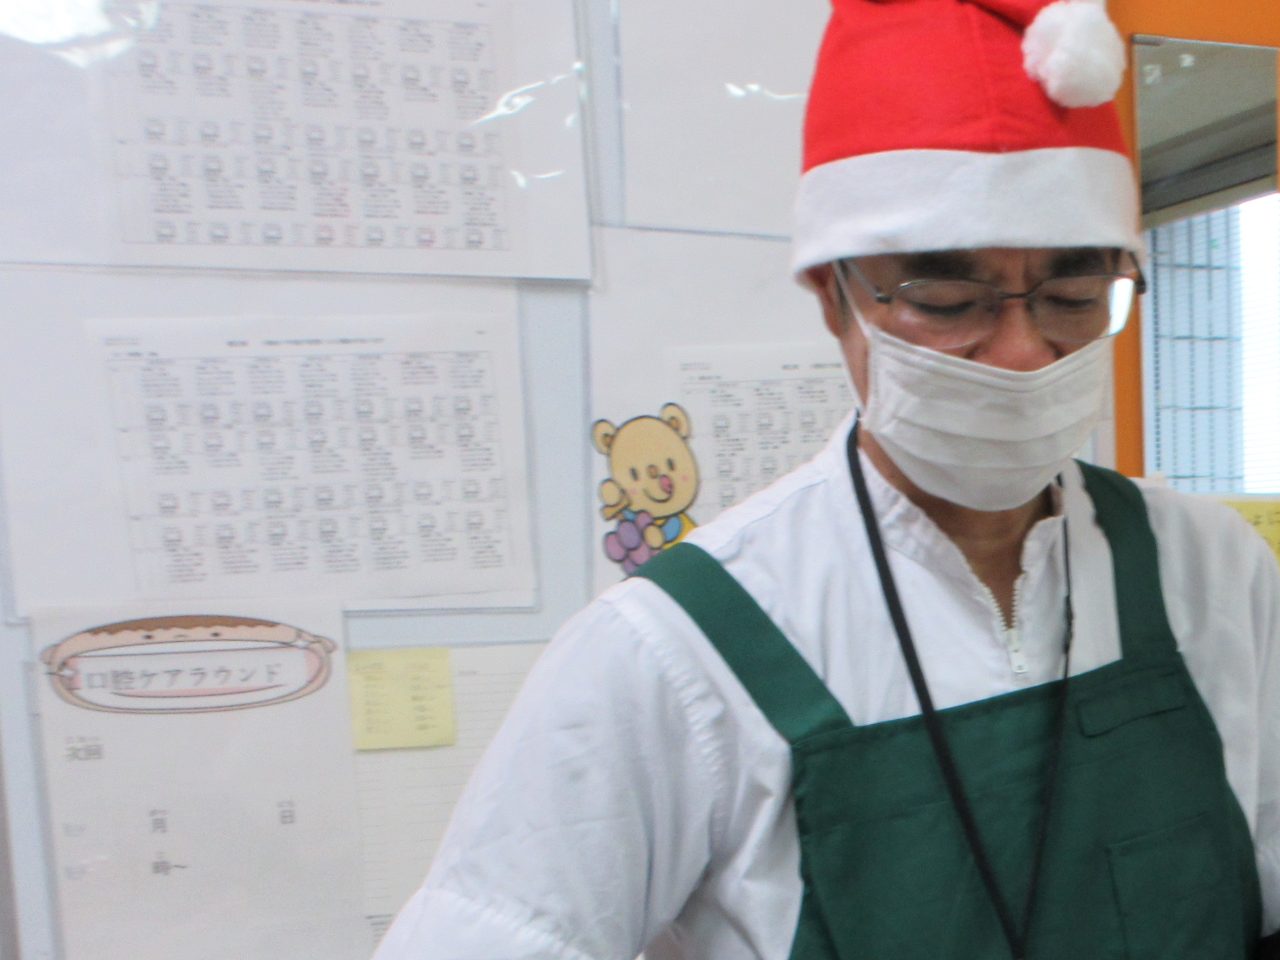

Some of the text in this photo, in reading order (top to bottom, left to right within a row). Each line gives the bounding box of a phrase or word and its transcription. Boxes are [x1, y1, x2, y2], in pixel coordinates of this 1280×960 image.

[86, 662, 282, 690] 口腔ケアラウンド
